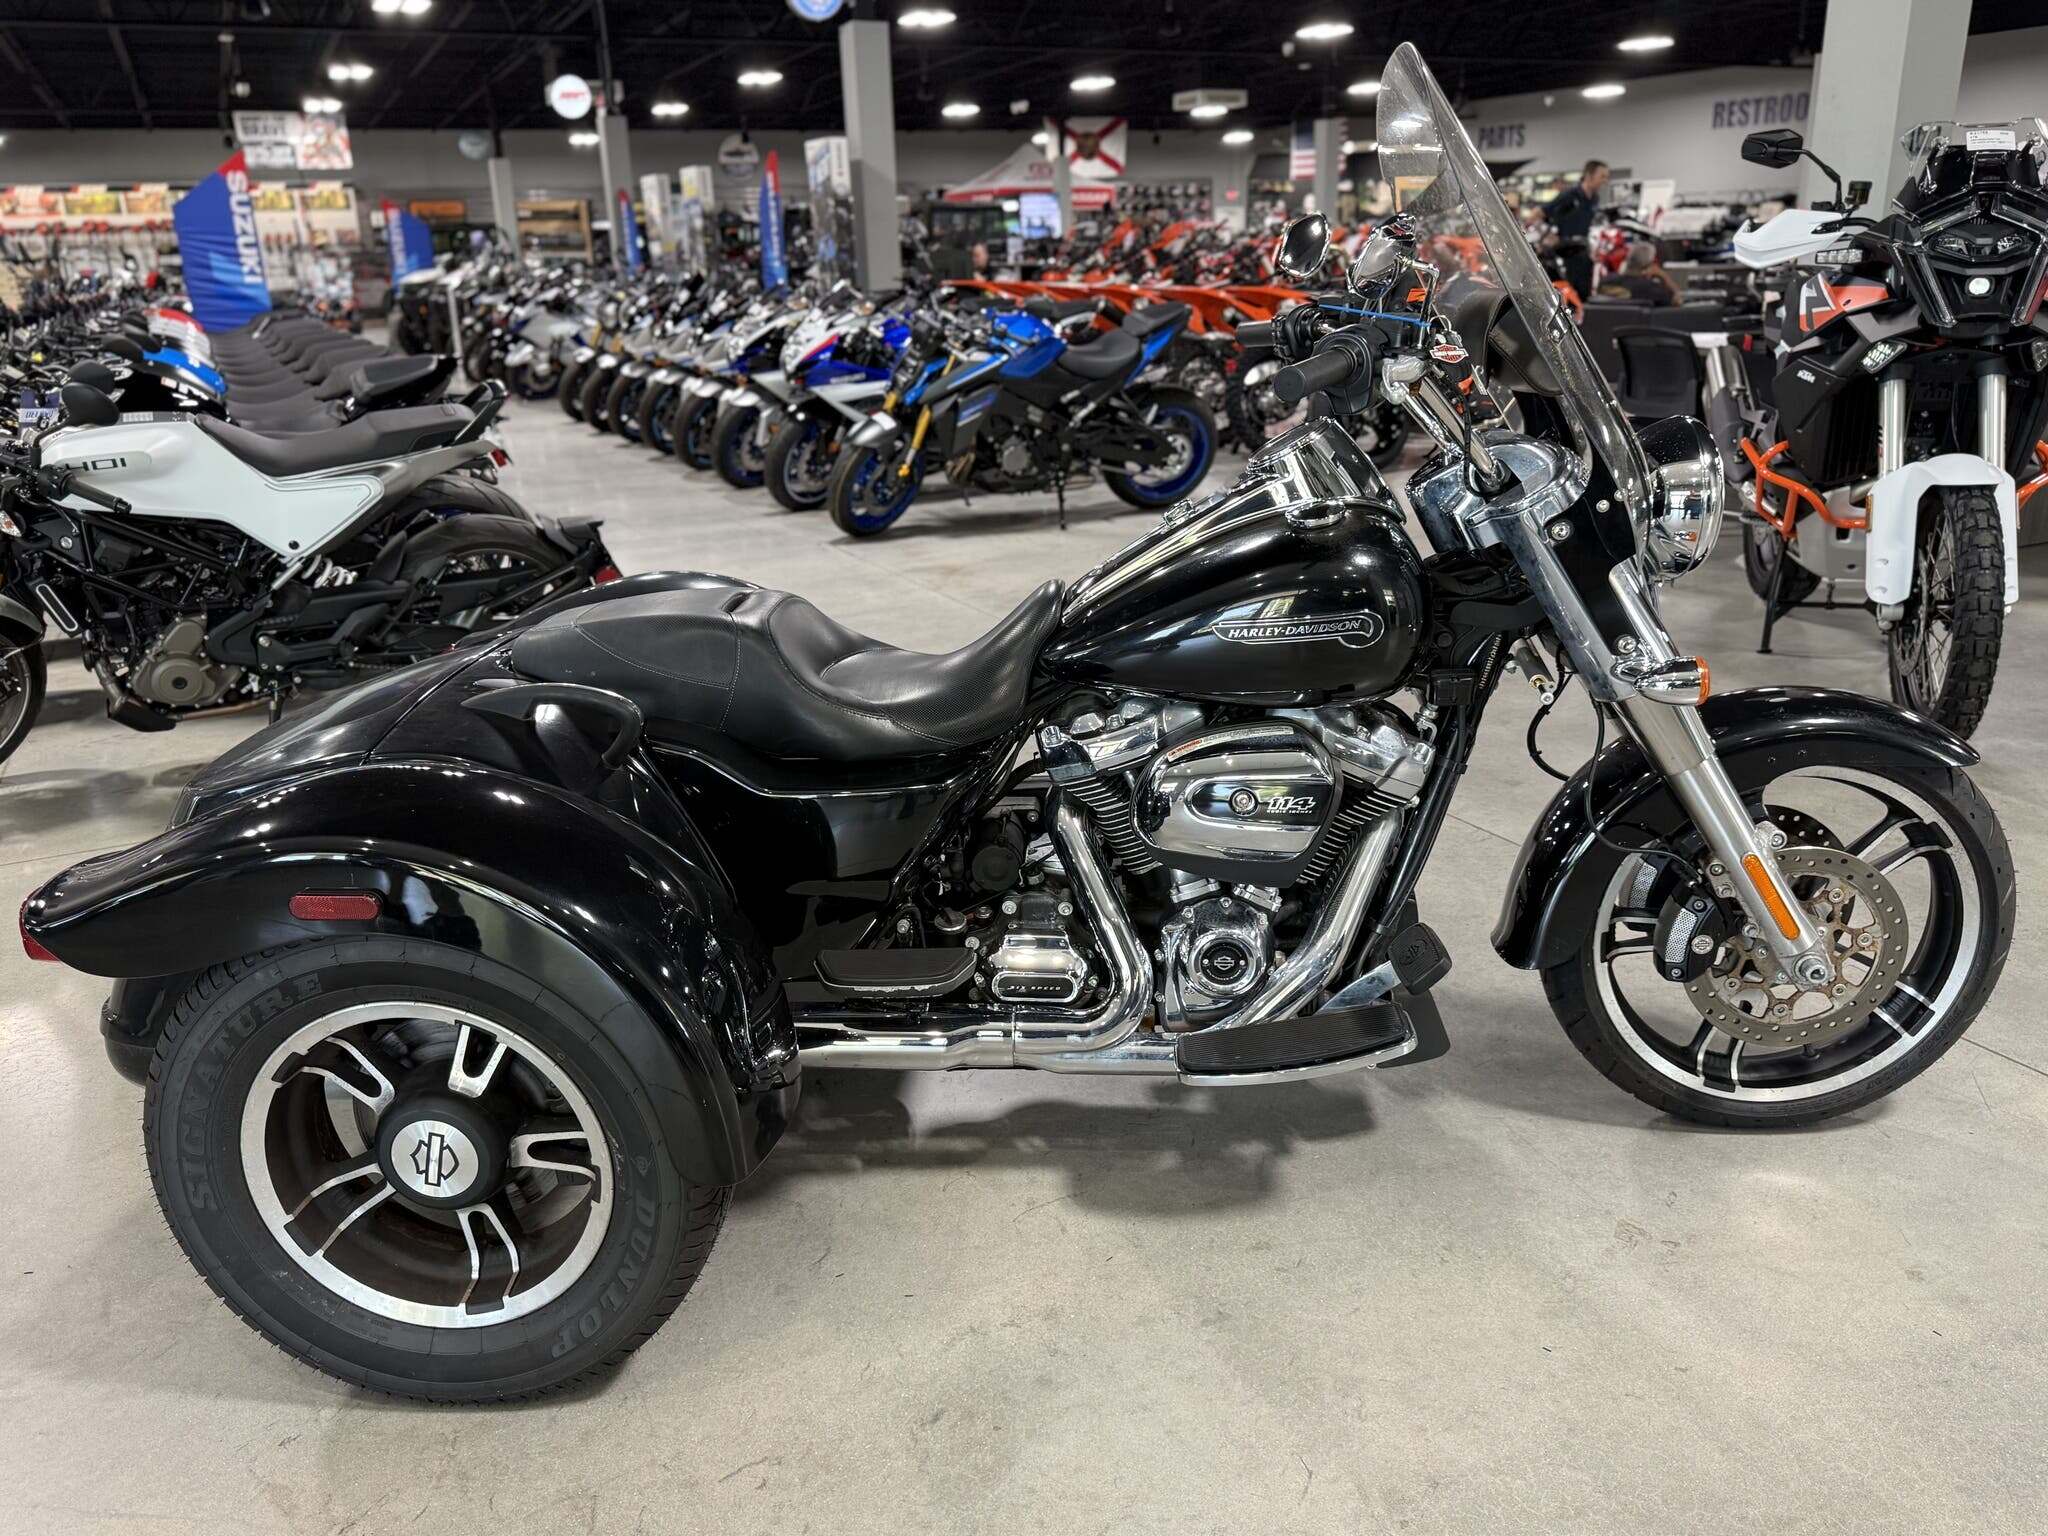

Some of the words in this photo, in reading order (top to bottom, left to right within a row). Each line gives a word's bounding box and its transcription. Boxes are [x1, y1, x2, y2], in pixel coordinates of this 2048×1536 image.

[1479, 123, 1526, 151] PARTS
[226, 169, 264, 284] SUZUKI
[1796, 369, 1816, 384] KTM
[1227, 618, 1362, 639] HARLEY-DAVIDSON
[1267, 796, 1317, 810] 114
[178, 971, 323, 1213] SIGNATURE
[551, 1189, 657, 1359] DUNLOP
